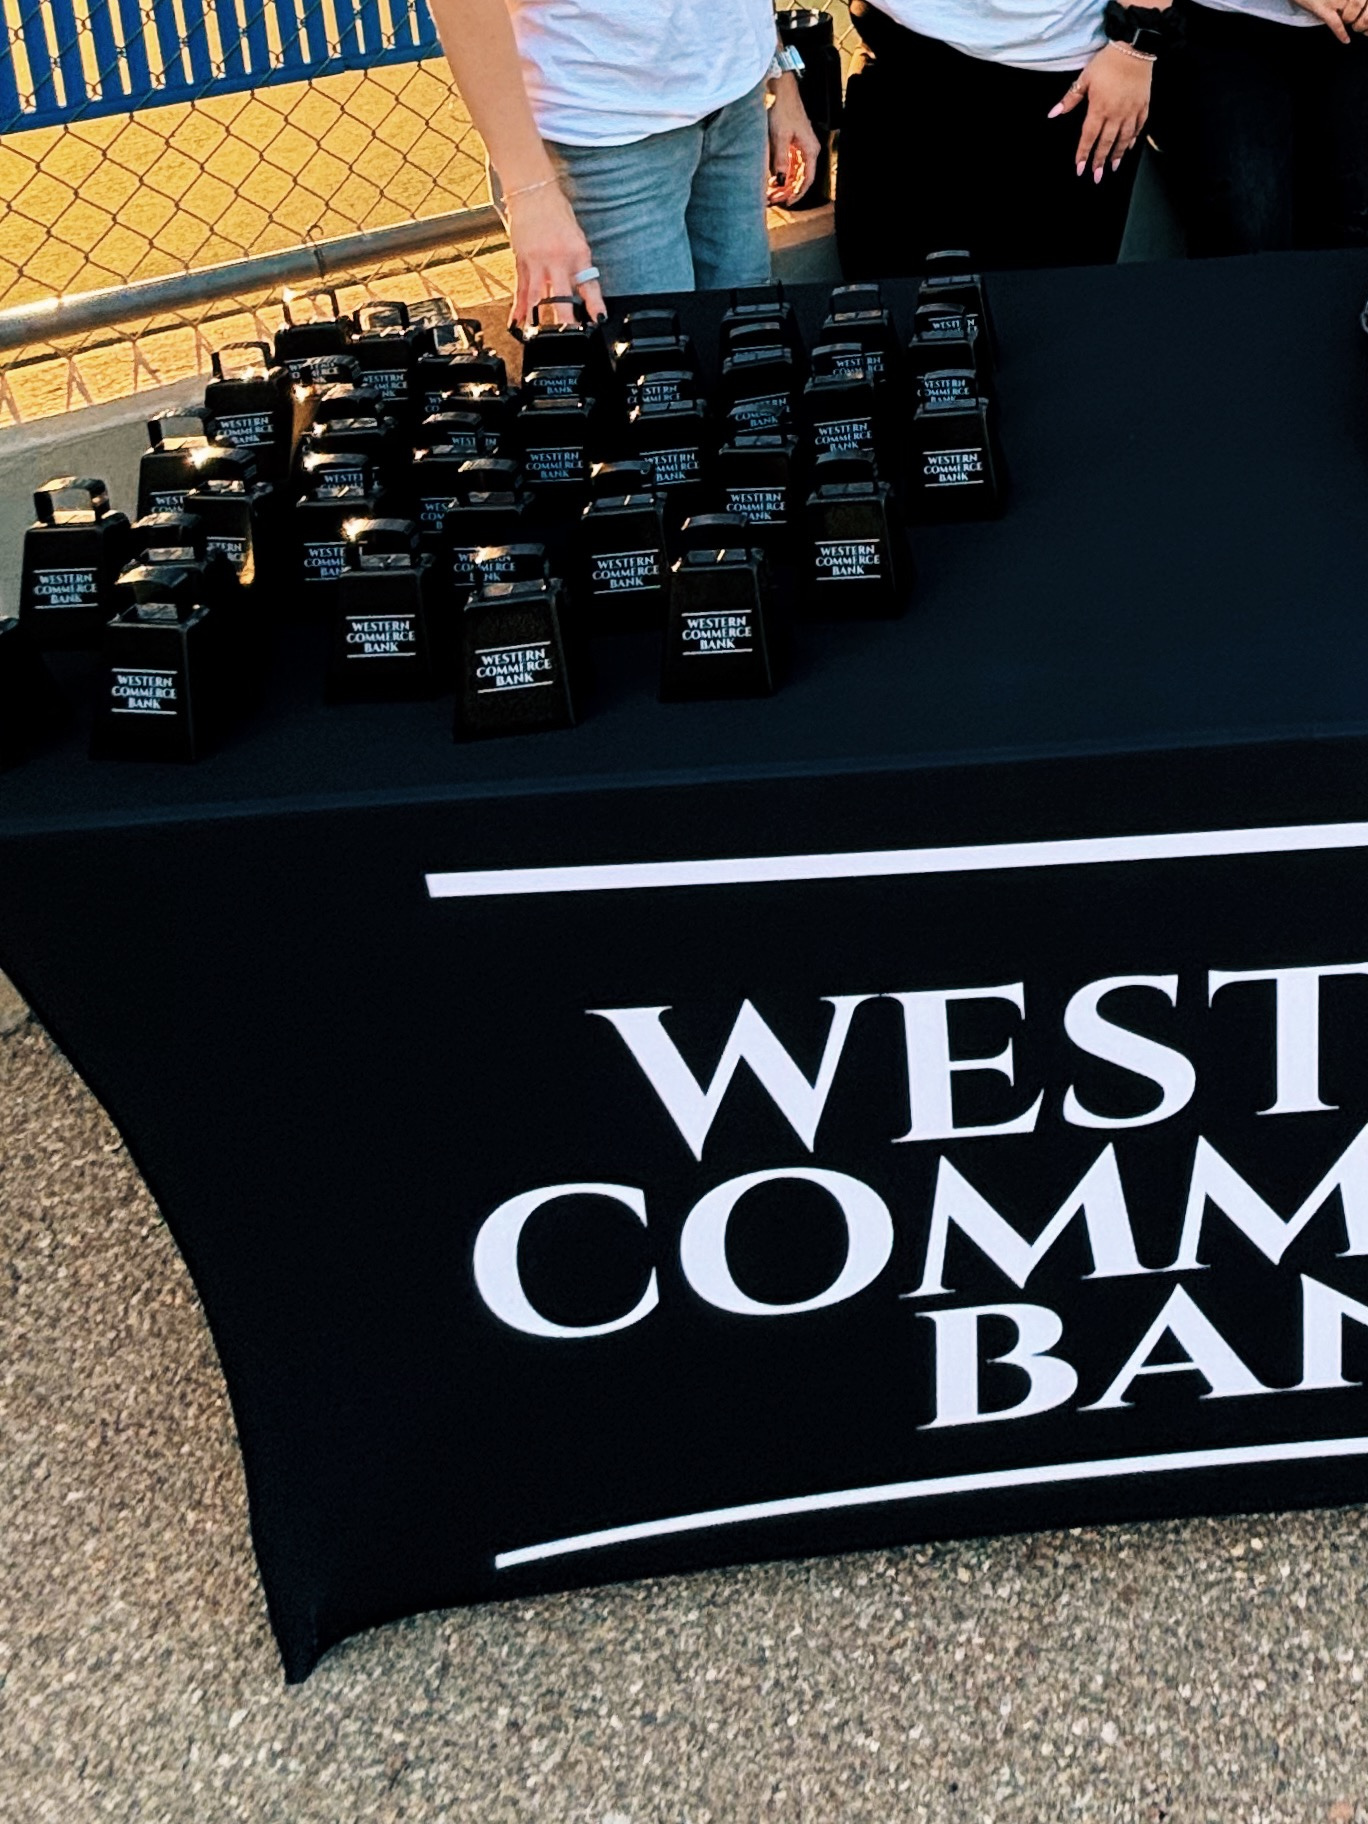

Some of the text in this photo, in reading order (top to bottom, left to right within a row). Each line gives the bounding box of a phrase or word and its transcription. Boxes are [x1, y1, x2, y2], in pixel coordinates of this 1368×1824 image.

[836, 356, 881, 367] WESTRN
[533, 378, 578, 386] COMMER
[631, 385, 677, 395] WSTERN
[220, 416, 269, 428] WESTERN
[819, 423, 868, 436] WESTERN
[814, 430, 873, 445] COMMERCE
[529, 451, 580, 461] WESTERN
[928, 453, 978, 465] WESTERN
[525, 460, 583, 470] COMMERCE
[923, 462, 983, 475] COMMERCE
[938, 473, 969, 483] BANK
[730, 492, 781, 503] WESTERN
[726, 501, 786, 512] COMMERCE
[819, 544, 876, 556] WESTERN
[597, 554, 655, 569] WESTERN
[815, 554, 881, 567] COMMERCE
[592, 564, 660, 581] COMMERCE
[832, 565, 865, 576] BANK
[39, 573, 93, 585] WESTERN
[609, 576, 645, 589] BANK
[33, 583, 98, 596] COMMERCE
[50, 593, 83, 605] BANK
[351, 620, 410, 632] WESTERN
[687, 615, 747, 629] WESTERN
[346, 630, 416, 644] COMMERCE
[682, 626, 753, 641] COMMERCE
[364, 641, 399, 653] BANK
[699, 638, 736, 650] BANK
[481, 648, 546, 666] WESTERN
[476, 658, 552, 678] COMMERCE
[117, 675, 173, 687] WESTERN
[495, 672, 534, 687] BANK
[111, 685, 178, 699] COMMERCE
[128, 697, 162, 709] BANK
